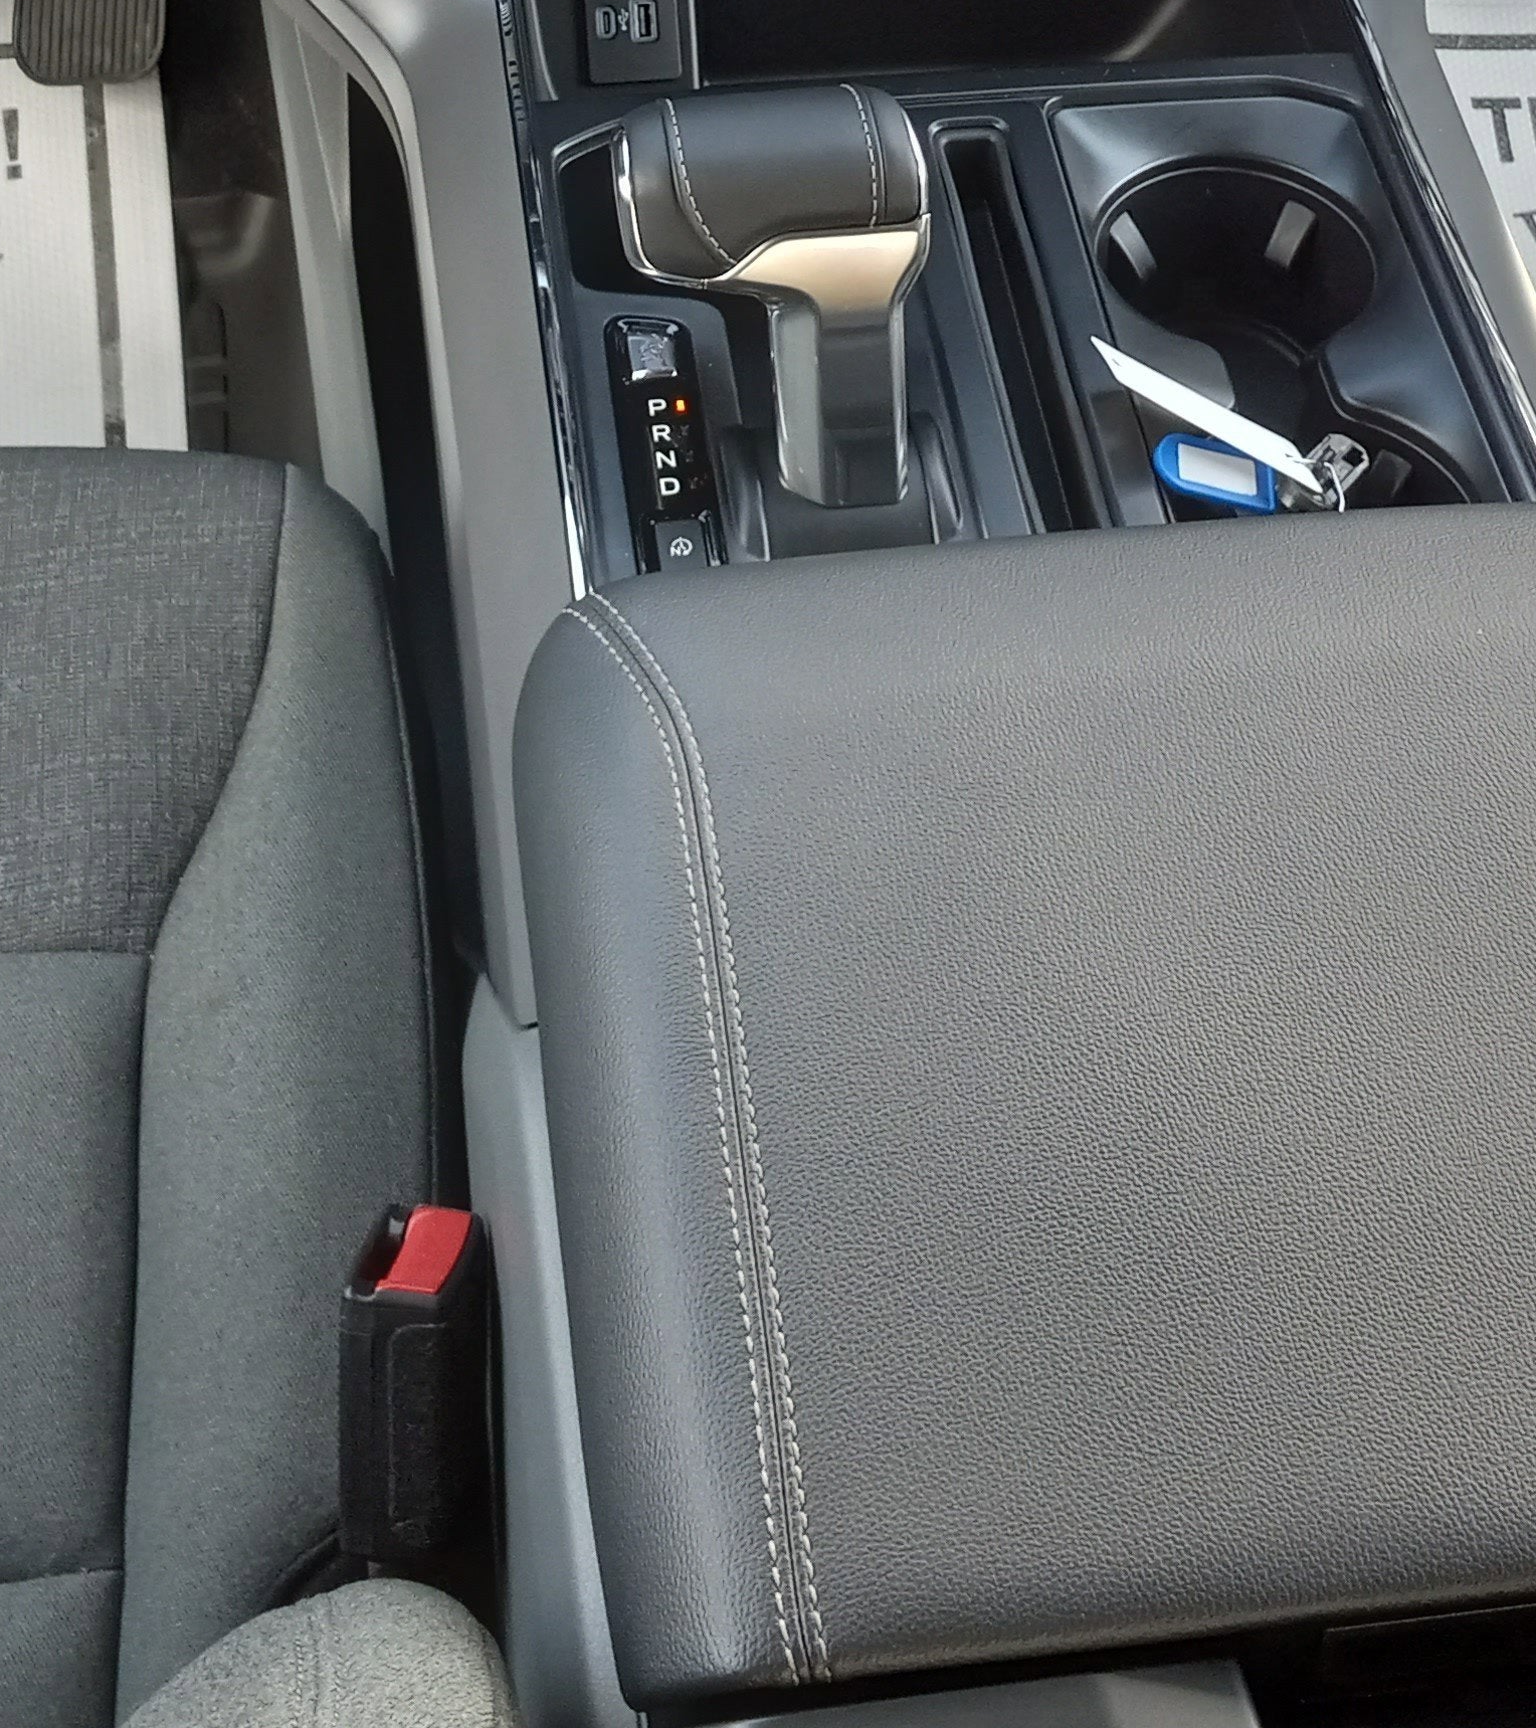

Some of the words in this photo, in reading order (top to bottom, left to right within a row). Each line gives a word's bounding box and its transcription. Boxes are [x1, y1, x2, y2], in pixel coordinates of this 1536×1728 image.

[648, 399, 667, 416] P
[652, 425, 671, 442] R
[656, 450, 677, 469] N
[659, 477, 680, 496] D
